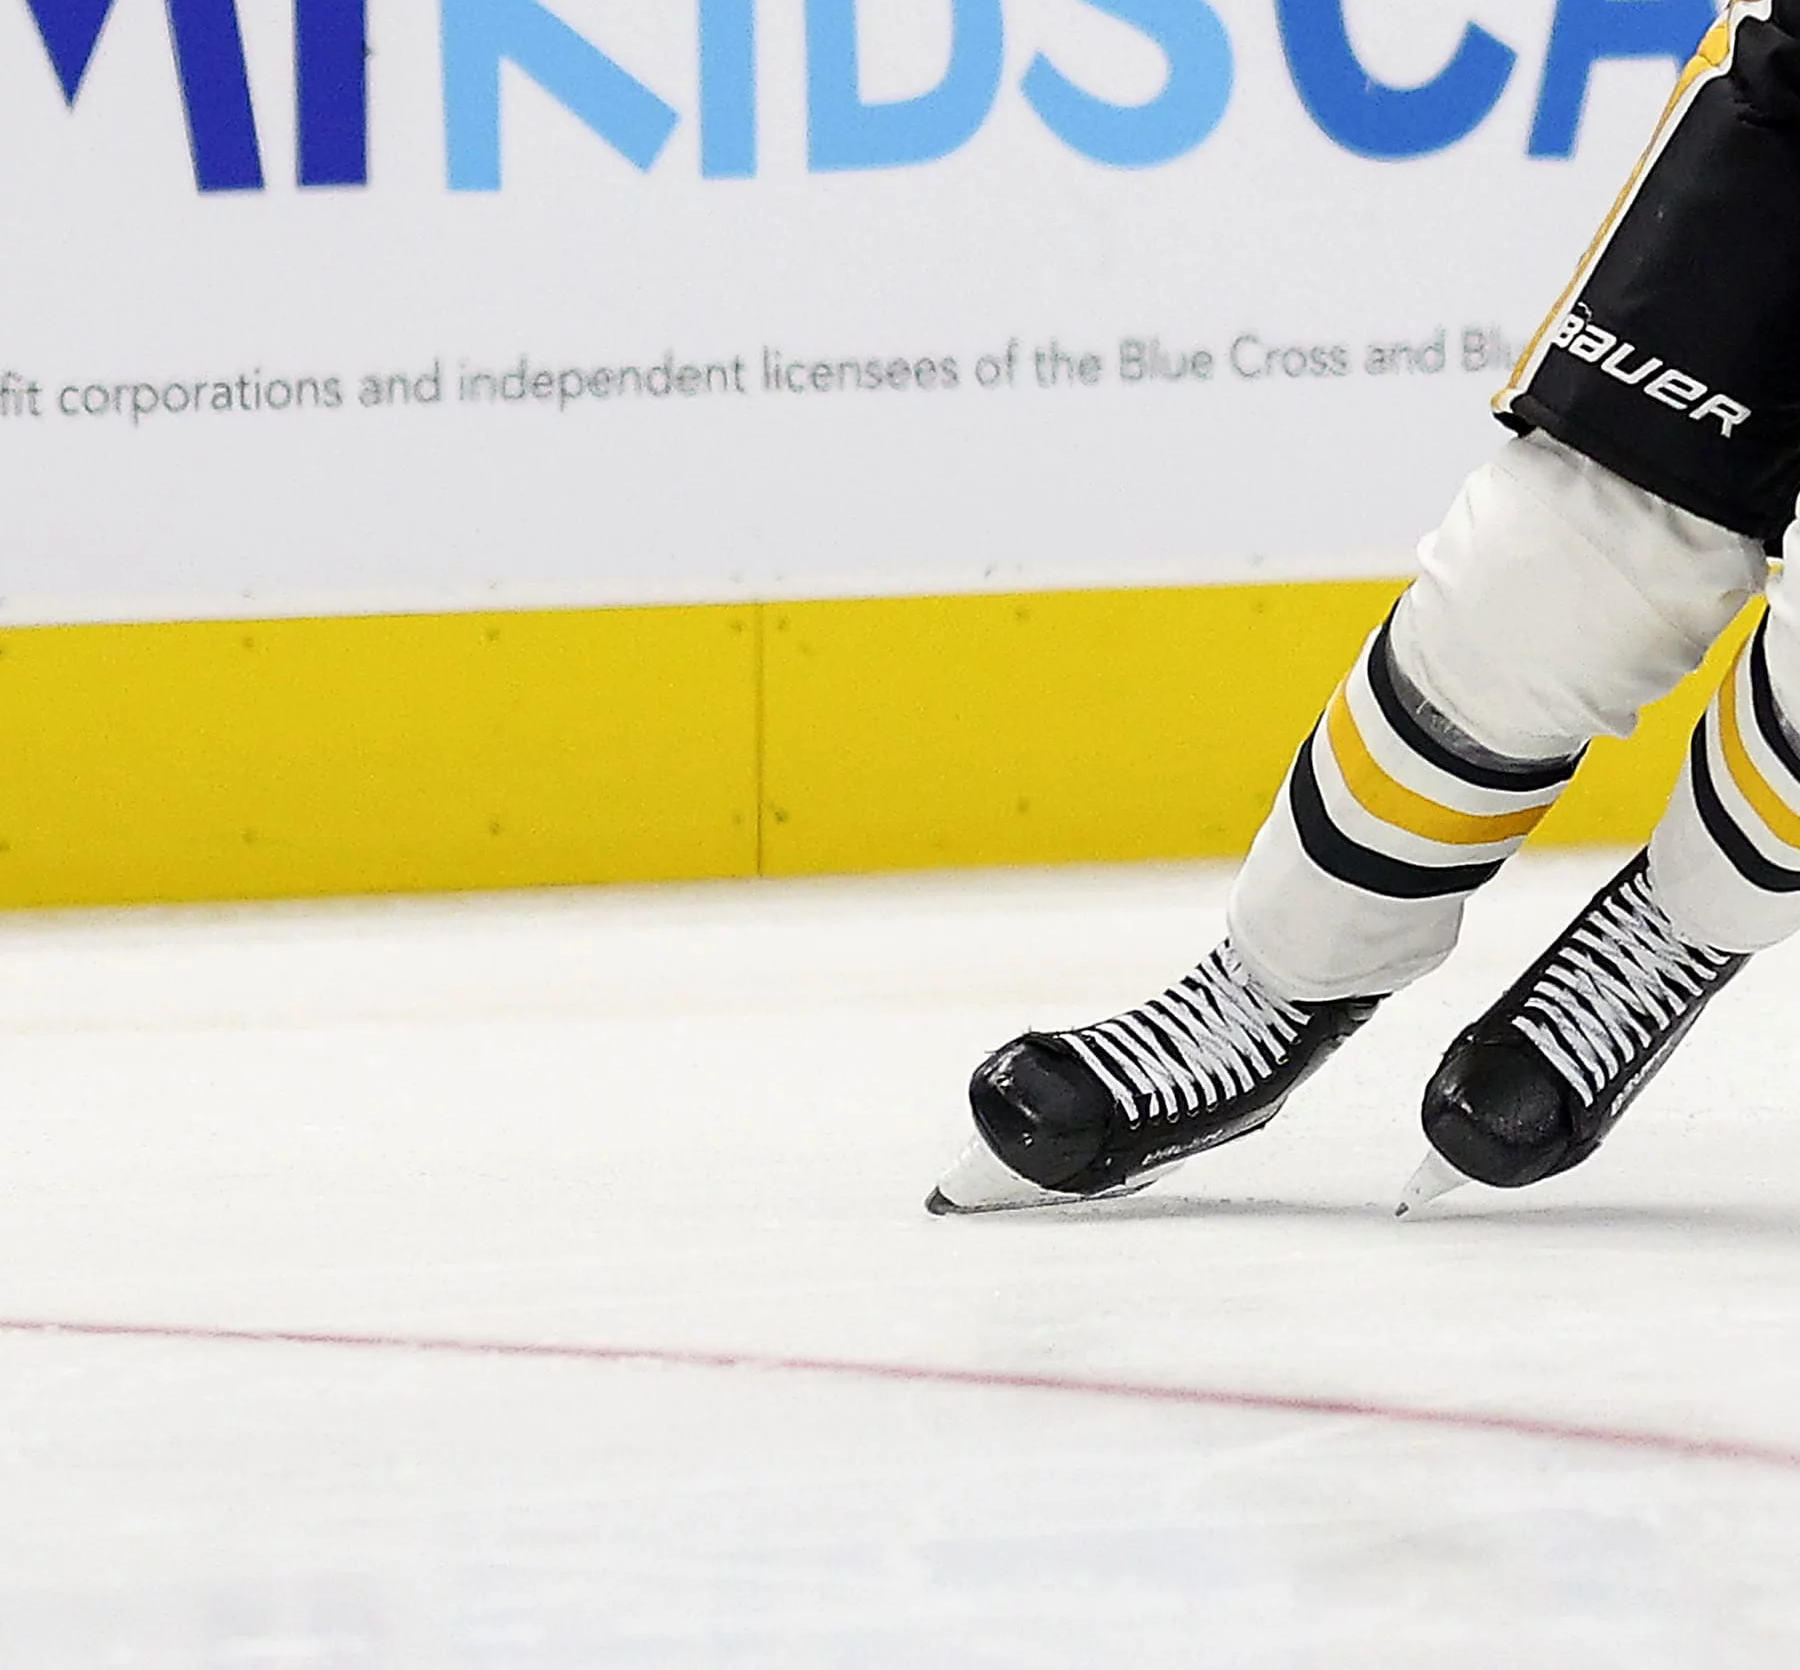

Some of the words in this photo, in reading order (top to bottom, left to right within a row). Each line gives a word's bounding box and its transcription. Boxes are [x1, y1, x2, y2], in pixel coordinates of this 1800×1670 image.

[57, 368, 343, 428] corporations
[358, 358, 442, 408] and
[459, 352, 746, 412] independent
[763, 345, 960, 394] licensees
[975, 337, 1018, 387] of
[1034, 340, 1103, 387] the
[1119, 337, 1214, 383] Blue
[1230, 333, 1349, 380] Cross
[1364, 328, 1446, 376] and
